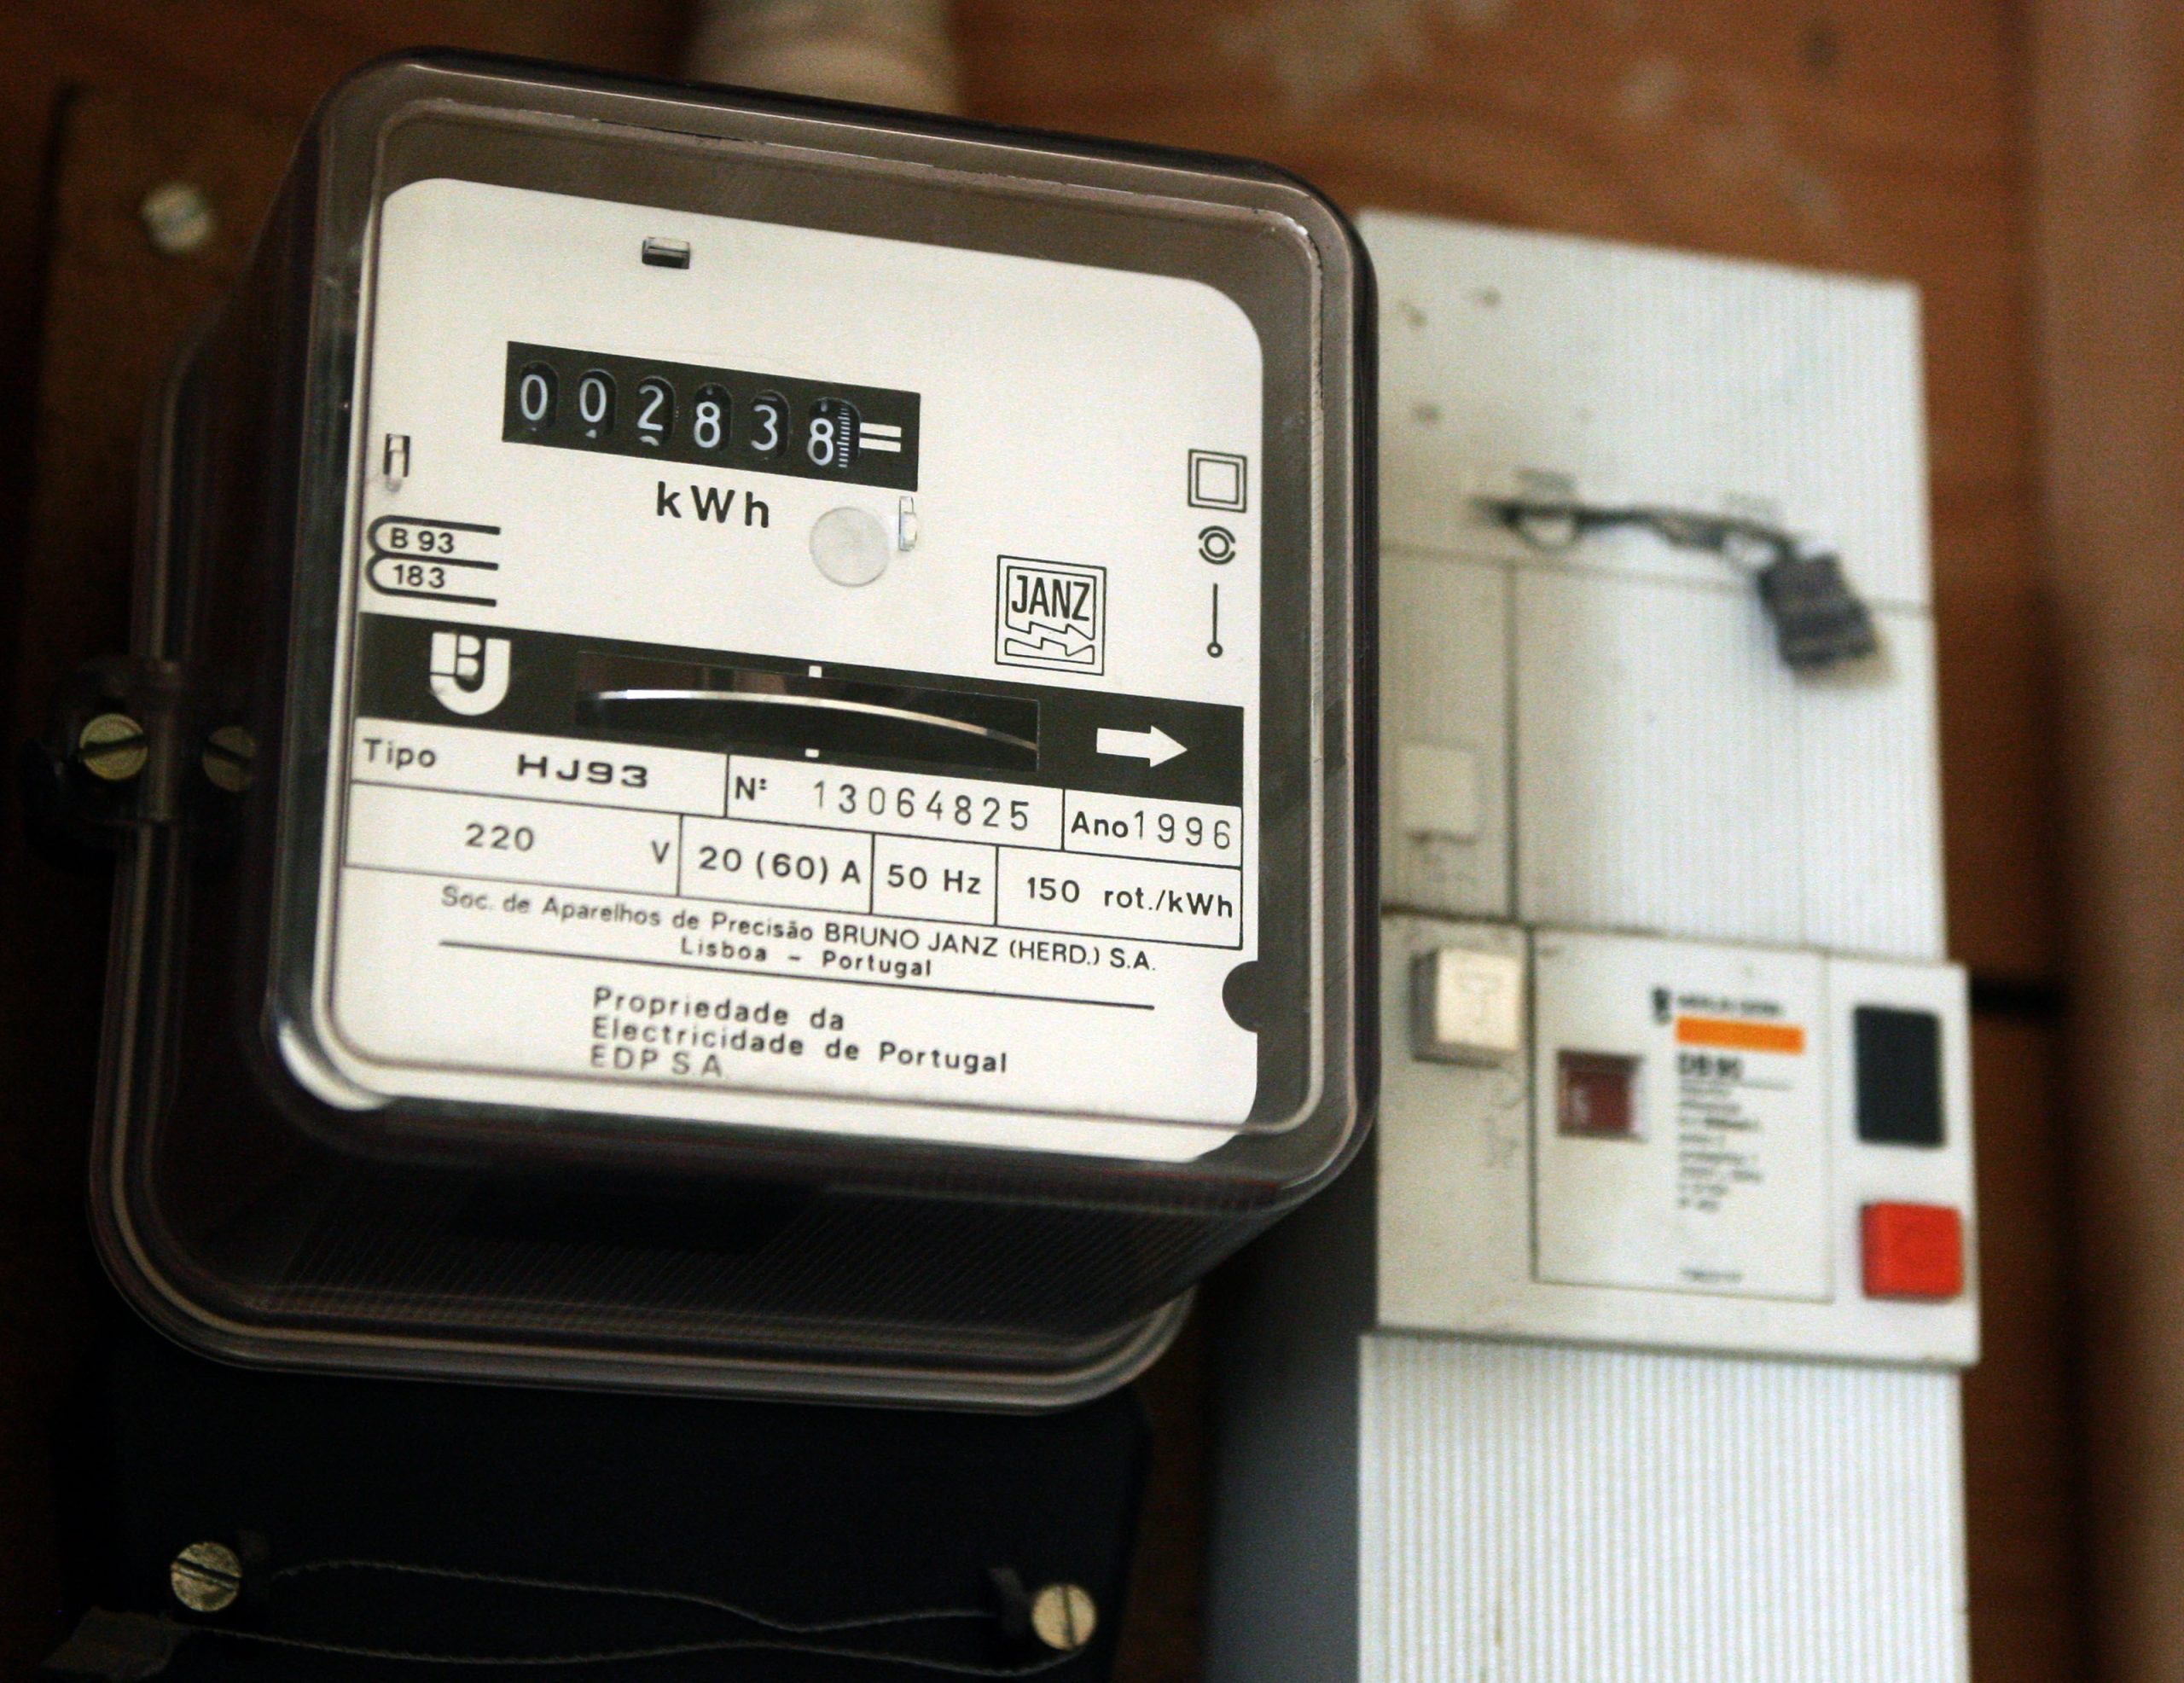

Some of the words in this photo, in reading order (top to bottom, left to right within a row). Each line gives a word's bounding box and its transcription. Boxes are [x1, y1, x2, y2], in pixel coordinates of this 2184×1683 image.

[520, 374, 834, 467] 002838
[656, 481, 770, 529] kWh
[390, 527, 408, 549] B
[418, 531, 455, 554] 93
[392, 564, 445, 589] 183
[1011, 574, 1091, 621] JANZ
[363, 738, 437, 769] Tipo
[516, 754, 648, 789] HJ93
[813, 780, 1031, 832] 13064825
[464, 823, 534, 852] 220
[651, 839, 671, 865] V
[1071, 810, 1129, 839] Ano
[1132, 810, 1232, 850] 1996
[698, 846, 741, 872] 20
[756, 851, 828, 884] (60)
[841, 860, 861, 885] A
[886, 864, 928, 890] 50
[943, 869, 982, 895] Hz
[1026, 877, 1080, 903] 150
[1103, 888, 1233, 919] rot./kWh
[441, 885, 494, 911] Soc.
[502, 894, 530, 914] de
[542, 897, 661, 927] Aparelhos
[672, 911, 700, 931] de
[711, 911, 814, 940] Precisão
[825, 923, 920, 950] BRUNO
[927, 931, 999, 957] JANZ
[1009, 939, 1101, 966] (HERD.)
[1109, 947, 1157, 972] S.A.
[681, 938, 768, 963] Lisboa
[822, 950, 932, 979] Portugal
[593, 986, 790, 1025] Propriedade
[810, 1007, 845, 1031] da
[590, 1045, 659, 1070] EDP
[591, 1017, 804, 1056] Electricidade
[825, 1038, 860, 1060] de
[879, 1042, 1008, 1075] Portugal
